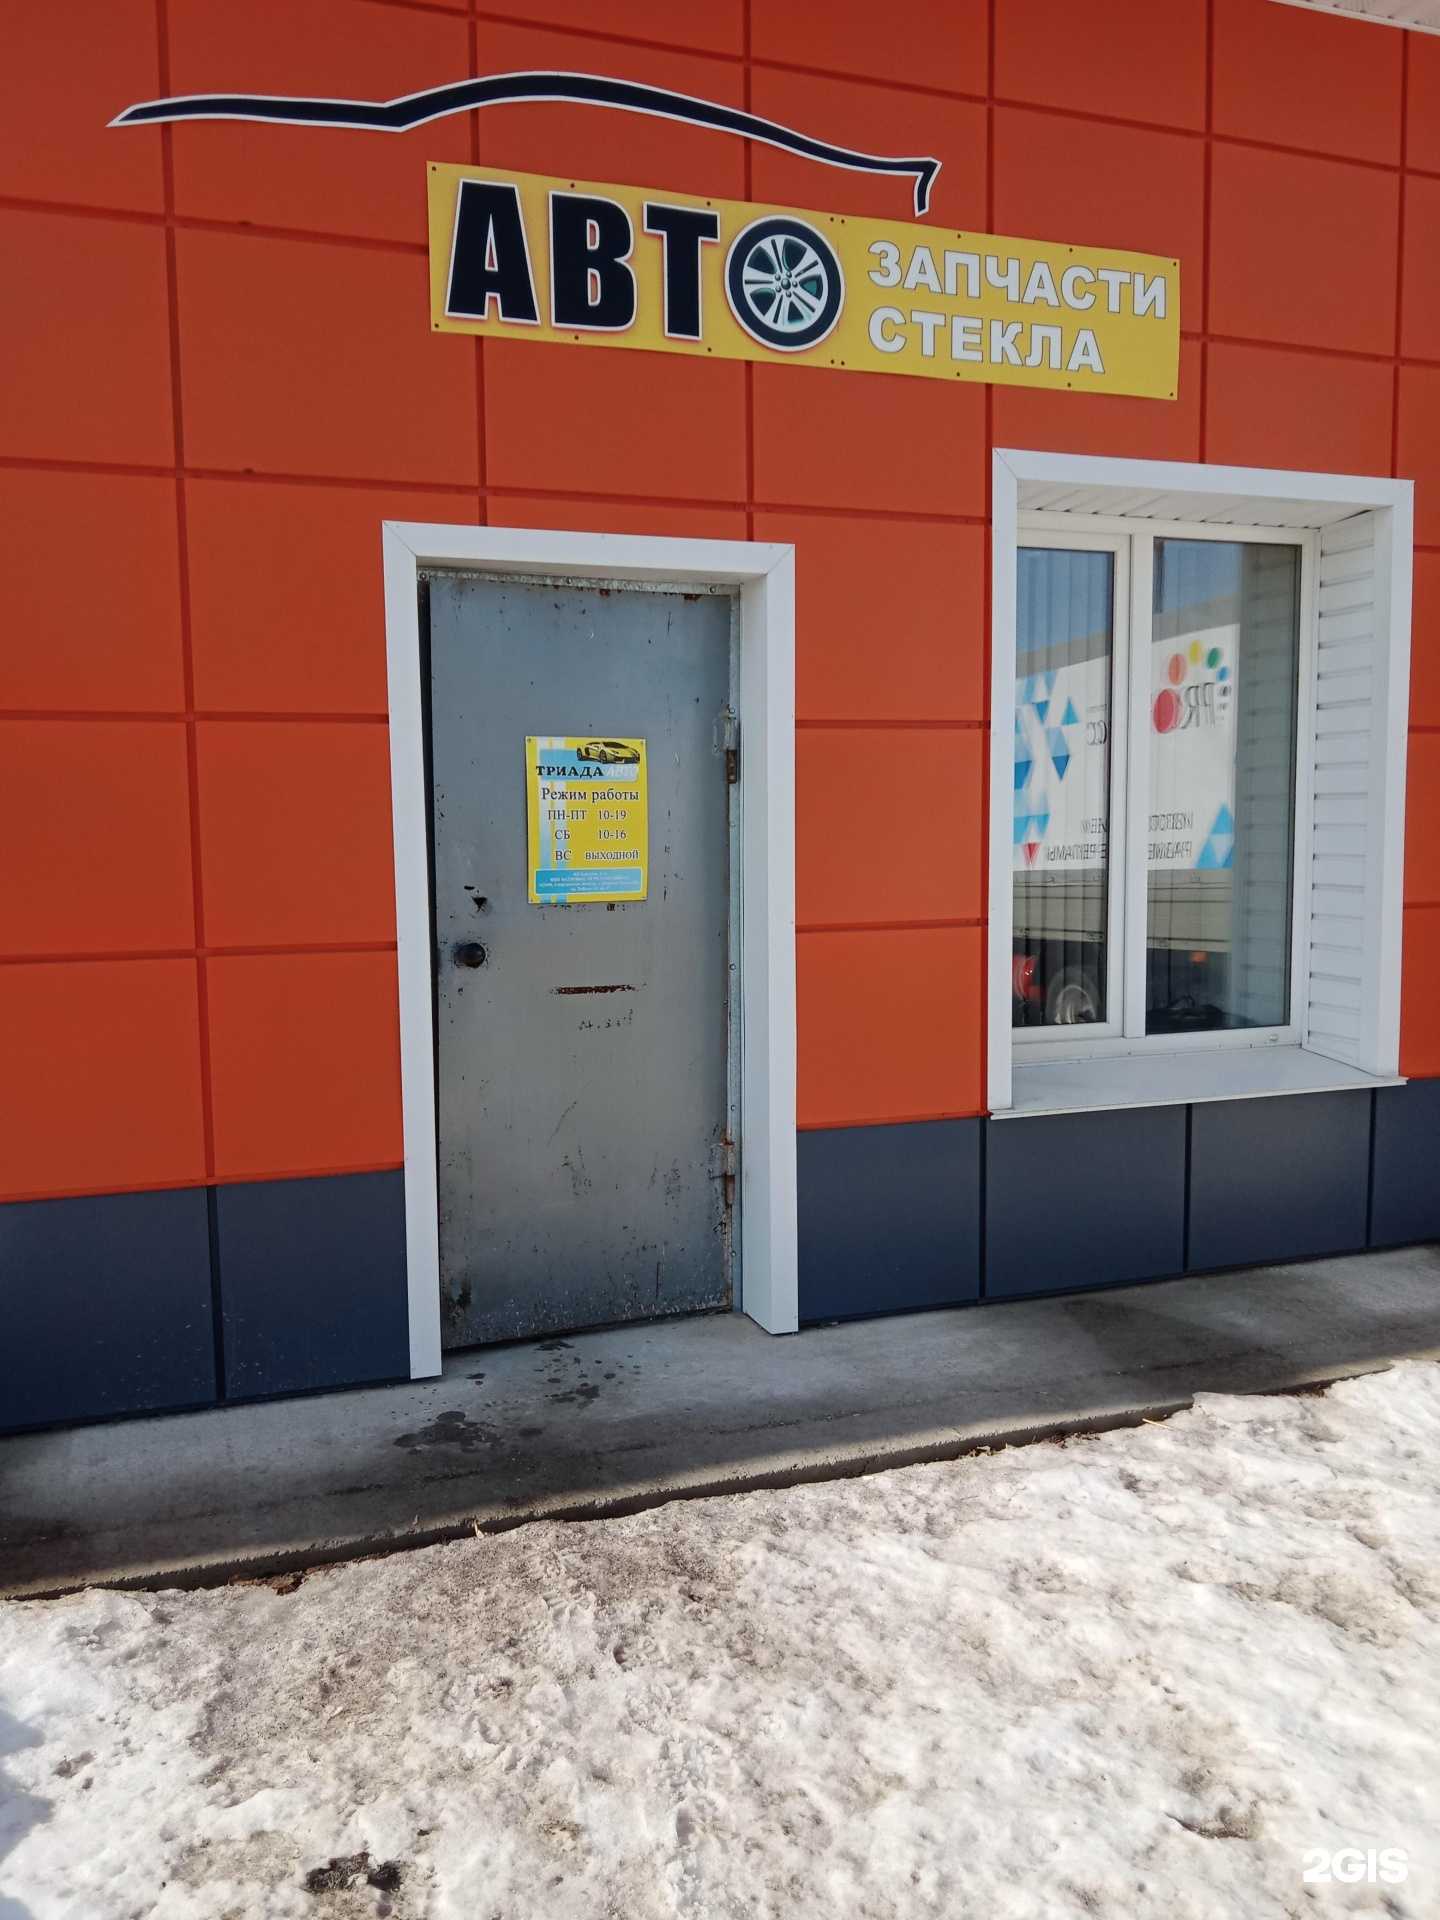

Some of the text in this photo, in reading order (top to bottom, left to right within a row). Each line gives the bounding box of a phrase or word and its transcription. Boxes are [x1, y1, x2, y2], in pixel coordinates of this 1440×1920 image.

[866, 239, 1168, 320] ЗАПЧАСТИ
[867, 306, 1106, 375] СТЕКЛА
[535, 765, 604, 779] ТРИАДА
[541, 787, 640, 803] Режим работы
[547, 810, 627, 821] ПН-ПТ 10-19
[554, 829, 627, 841] СБ 10-16
[555, 849, 640, 861] ВС выходной
